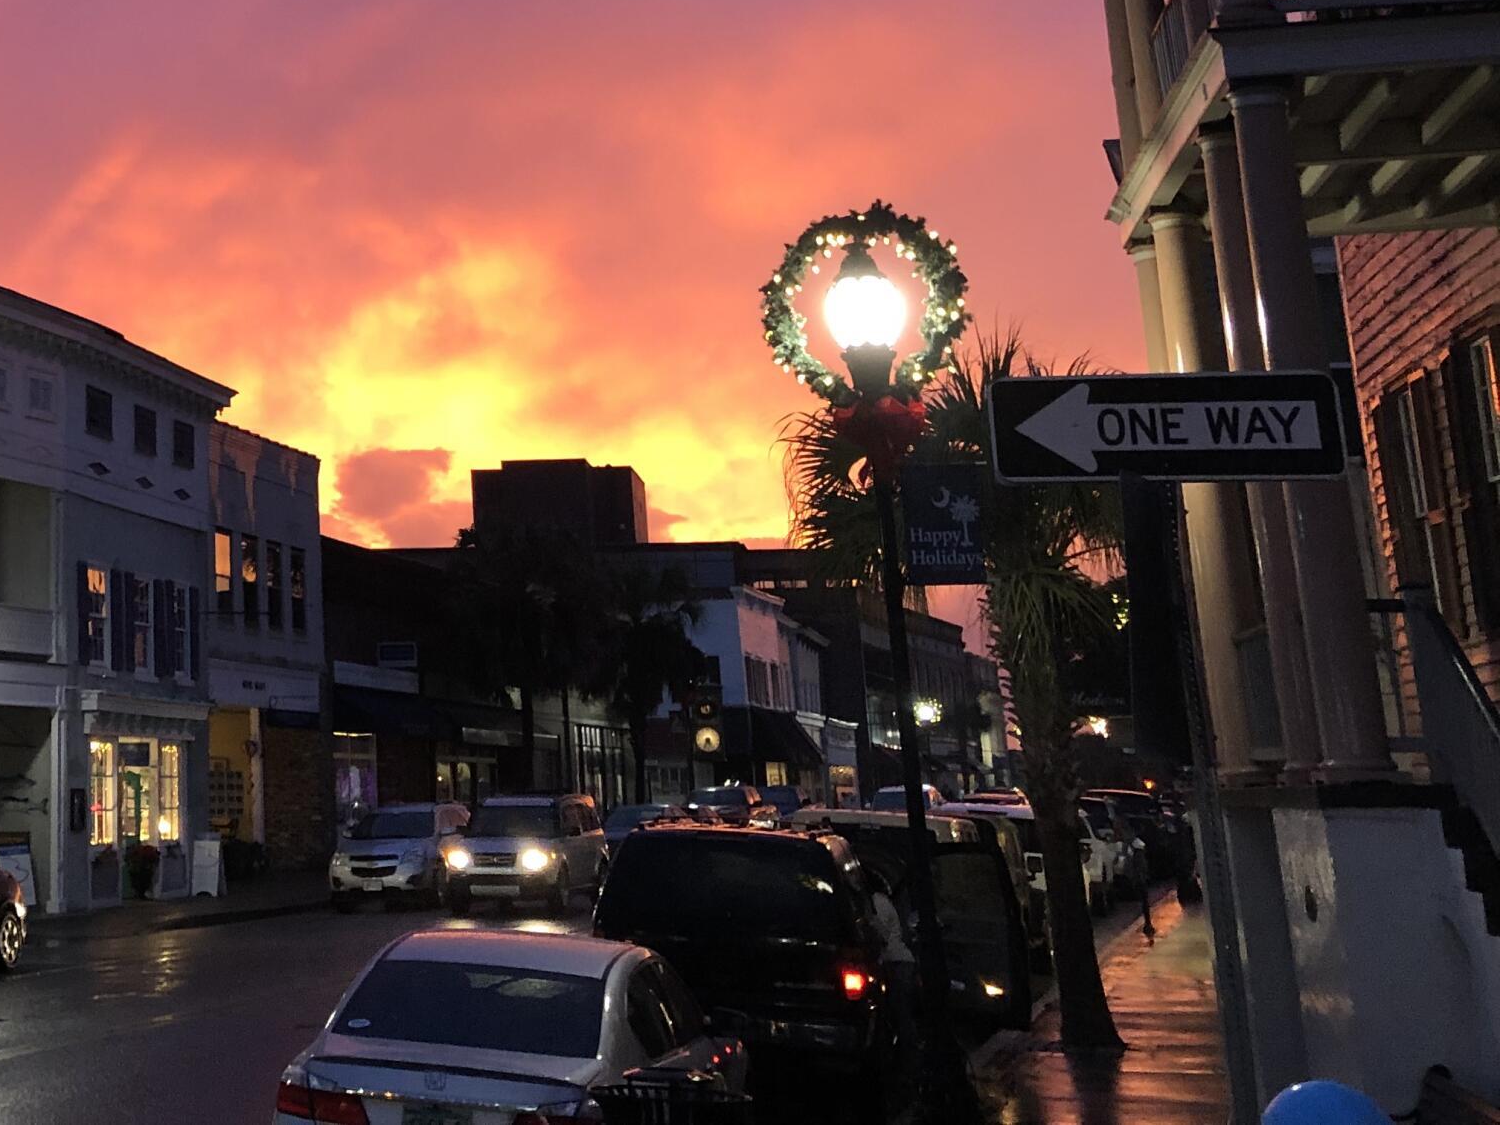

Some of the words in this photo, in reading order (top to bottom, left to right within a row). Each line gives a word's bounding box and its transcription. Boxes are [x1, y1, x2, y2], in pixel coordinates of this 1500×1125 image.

[1096, 407, 1189, 446] ONE
[1205, 406, 1301, 444] WAY
[909, 527, 962, 547] Happy
[911, 549, 983, 571] Holidays
